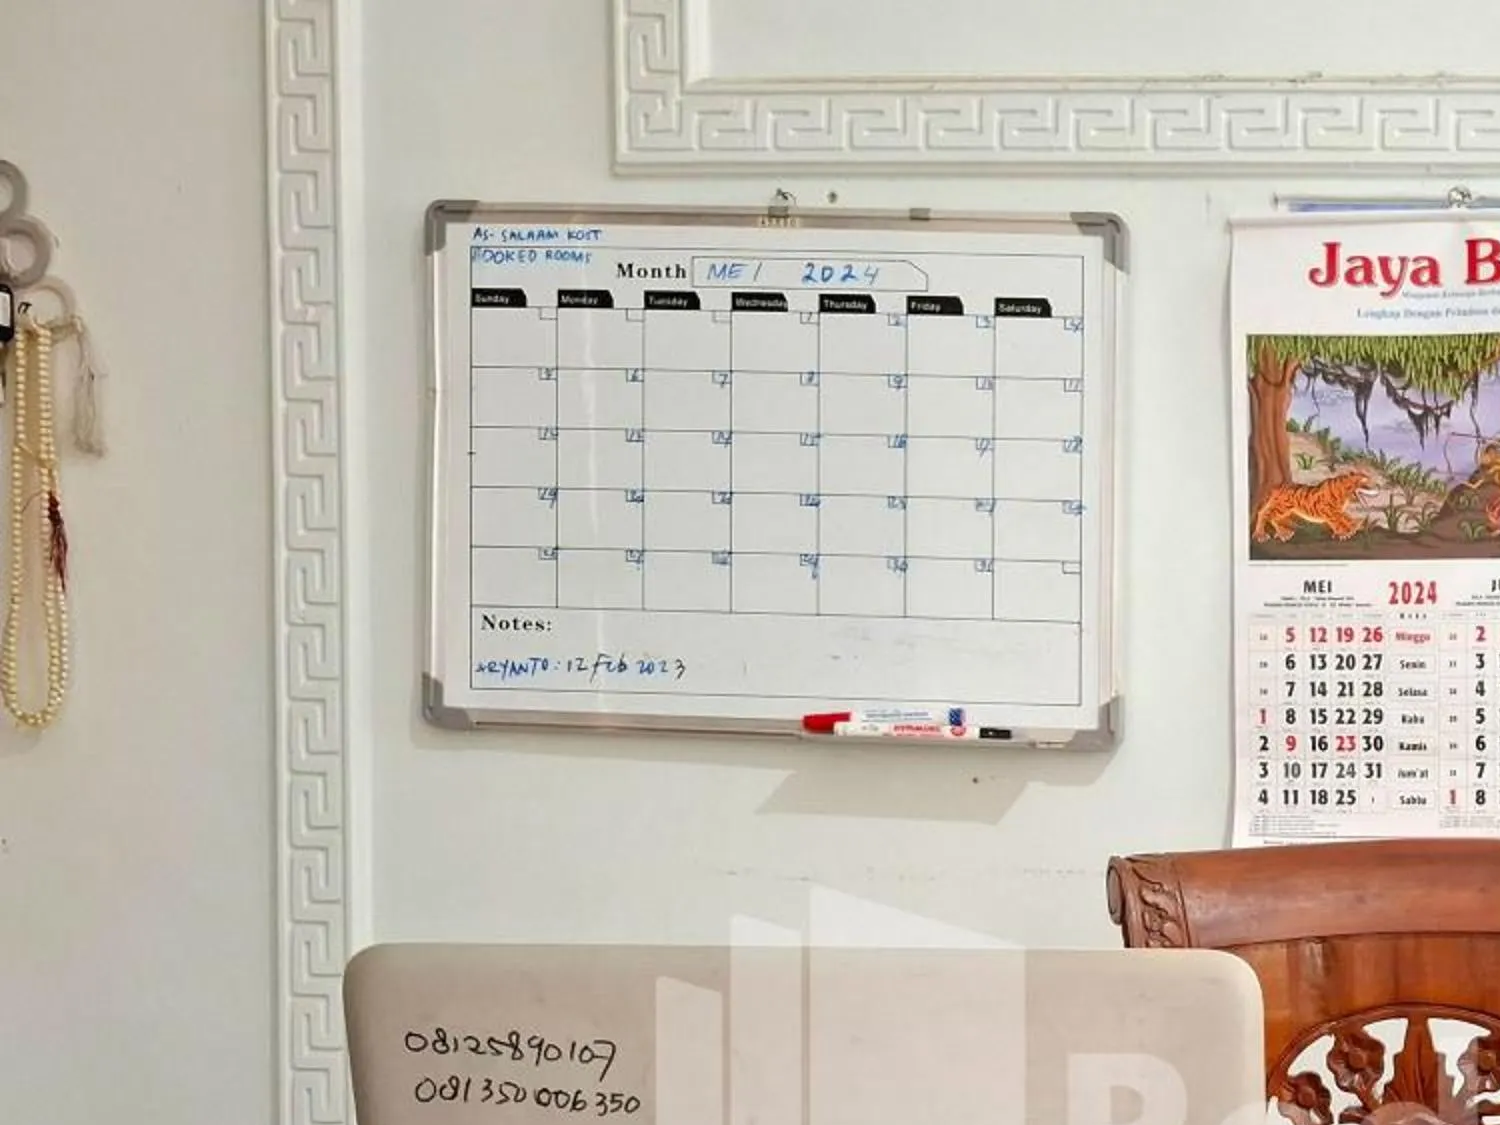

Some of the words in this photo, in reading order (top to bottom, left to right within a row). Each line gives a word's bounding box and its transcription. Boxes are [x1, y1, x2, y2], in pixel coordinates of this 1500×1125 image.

[616, 262, 688, 281] Month
[800, 262, 881, 285] 2024
[1307, 240, 1445, 298] Jaya
[475, 294, 510, 306] Sunday
[560, 295, 600, 307] Monday
[648, 296, 689, 308] Tuesday
[823, 299, 868, 311] Thursday
[910, 301, 942, 313] Friday
[999, 303, 1042, 315] Saturday
[1302, 579, 1333, 593] MEI
[1388, 581, 1438, 605] 2024
[480, 614, 553, 632] Notes:
[1285, 626, 1296, 643] 5
[1310, 626, 1328, 644] 12
[1336, 627, 1355, 643] 19
[1362, 626, 1384, 643] 26
[1395, 631, 1431, 645] Minggu
[1475, 625, 1486, 643] 2
[636, 657, 687, 681] 2023
[1285, 653, 1296, 671] 6
[1309, 653, 1327, 671] 13
[1335, 653, 1356, 671] 20
[1362, 653, 1383, 671] 27
[1399, 658, 1426, 670] Senin
[1475, 653, 1485, 670] 3
[1285, 681, 1296, 697] 7
[1309, 681, 1327, 697] 14
[1337, 681, 1354, 698] 21
[1362, 681, 1383, 697] 28
[1475, 680, 1486, 697] 4
[1260, 708, 1267, 725] 1
[1285, 707, 1297, 725] 8
[1310, 708, 1328, 725] 15
[1335, 708, 1357, 725] 22
[1362, 708, 1384, 725] 29
[1475, 707, 1486, 725] 5
[1259, 735, 1269, 752] 2
[1285, 735, 1297, 752] 9
[1310, 735, 1329, 752] 16
[1335, 735, 1356, 752] 23
[1362, 735, 1384, 752] 30
[1475, 735, 1487, 752] 6
[1259, 761, 1269, 779] 3
[1283, 762, 1301, 779] 10
[1311, 762, 1328, 779] 17
[1335, 762, 1357, 779] 24
[1364, 762, 1382, 779] 31
[1475, 761, 1486, 779] 7
[1258, 789, 1269, 805] 4
[1283, 789, 1299, 805] 11
[1310, 789, 1329, 805] 18
[1335, 789, 1357, 806] 25
[1449, 789, 1457, 805] 1
[1475, 789, 1486, 806] 8
[404, 1027, 618, 1082] 08125890107
